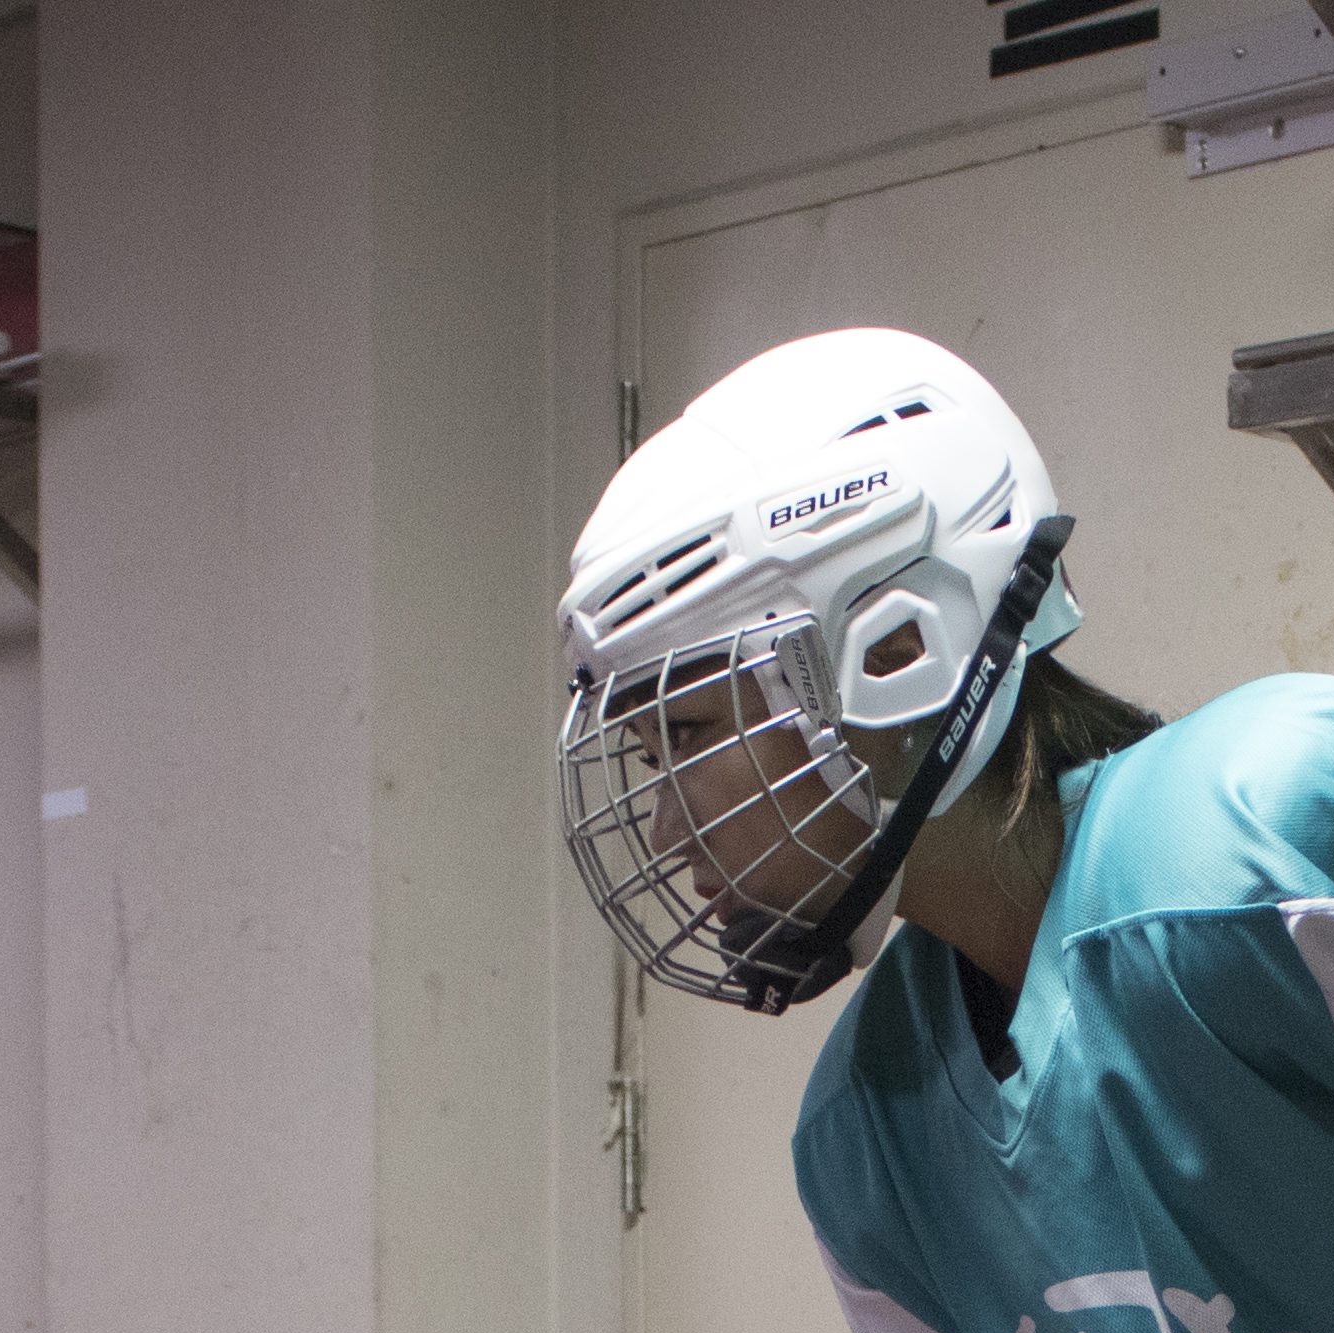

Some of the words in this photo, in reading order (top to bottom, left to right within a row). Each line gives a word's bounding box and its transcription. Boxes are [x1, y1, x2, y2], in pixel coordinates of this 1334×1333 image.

[770, 471, 889, 529] BAUER
[790, 637, 819, 711] BAUER
[938, 654, 996, 764] BAUER
